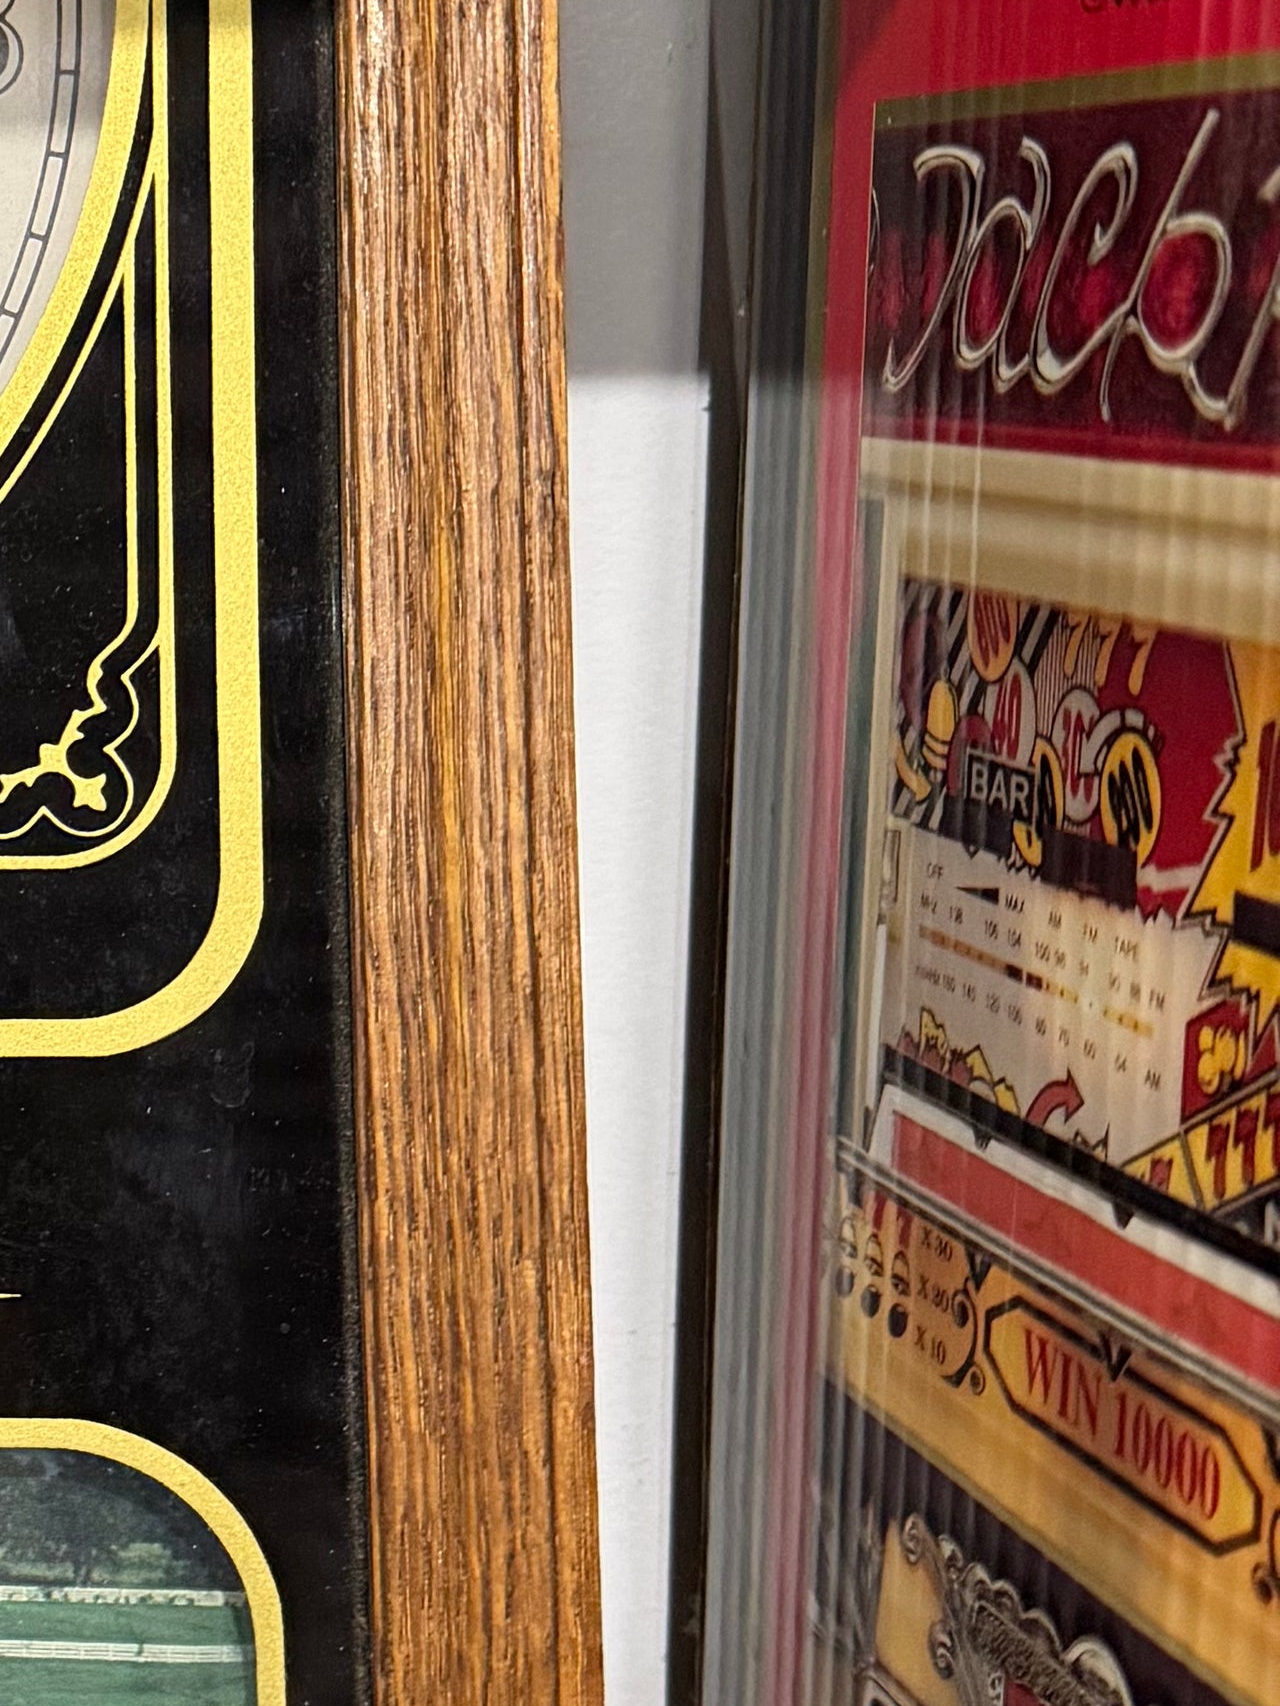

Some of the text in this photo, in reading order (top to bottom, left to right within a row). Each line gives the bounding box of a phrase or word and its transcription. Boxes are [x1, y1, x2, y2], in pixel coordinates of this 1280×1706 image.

[970, 758, 1030, 816] BAR
[1025, 1329, 1220, 1521] WIN 10000
